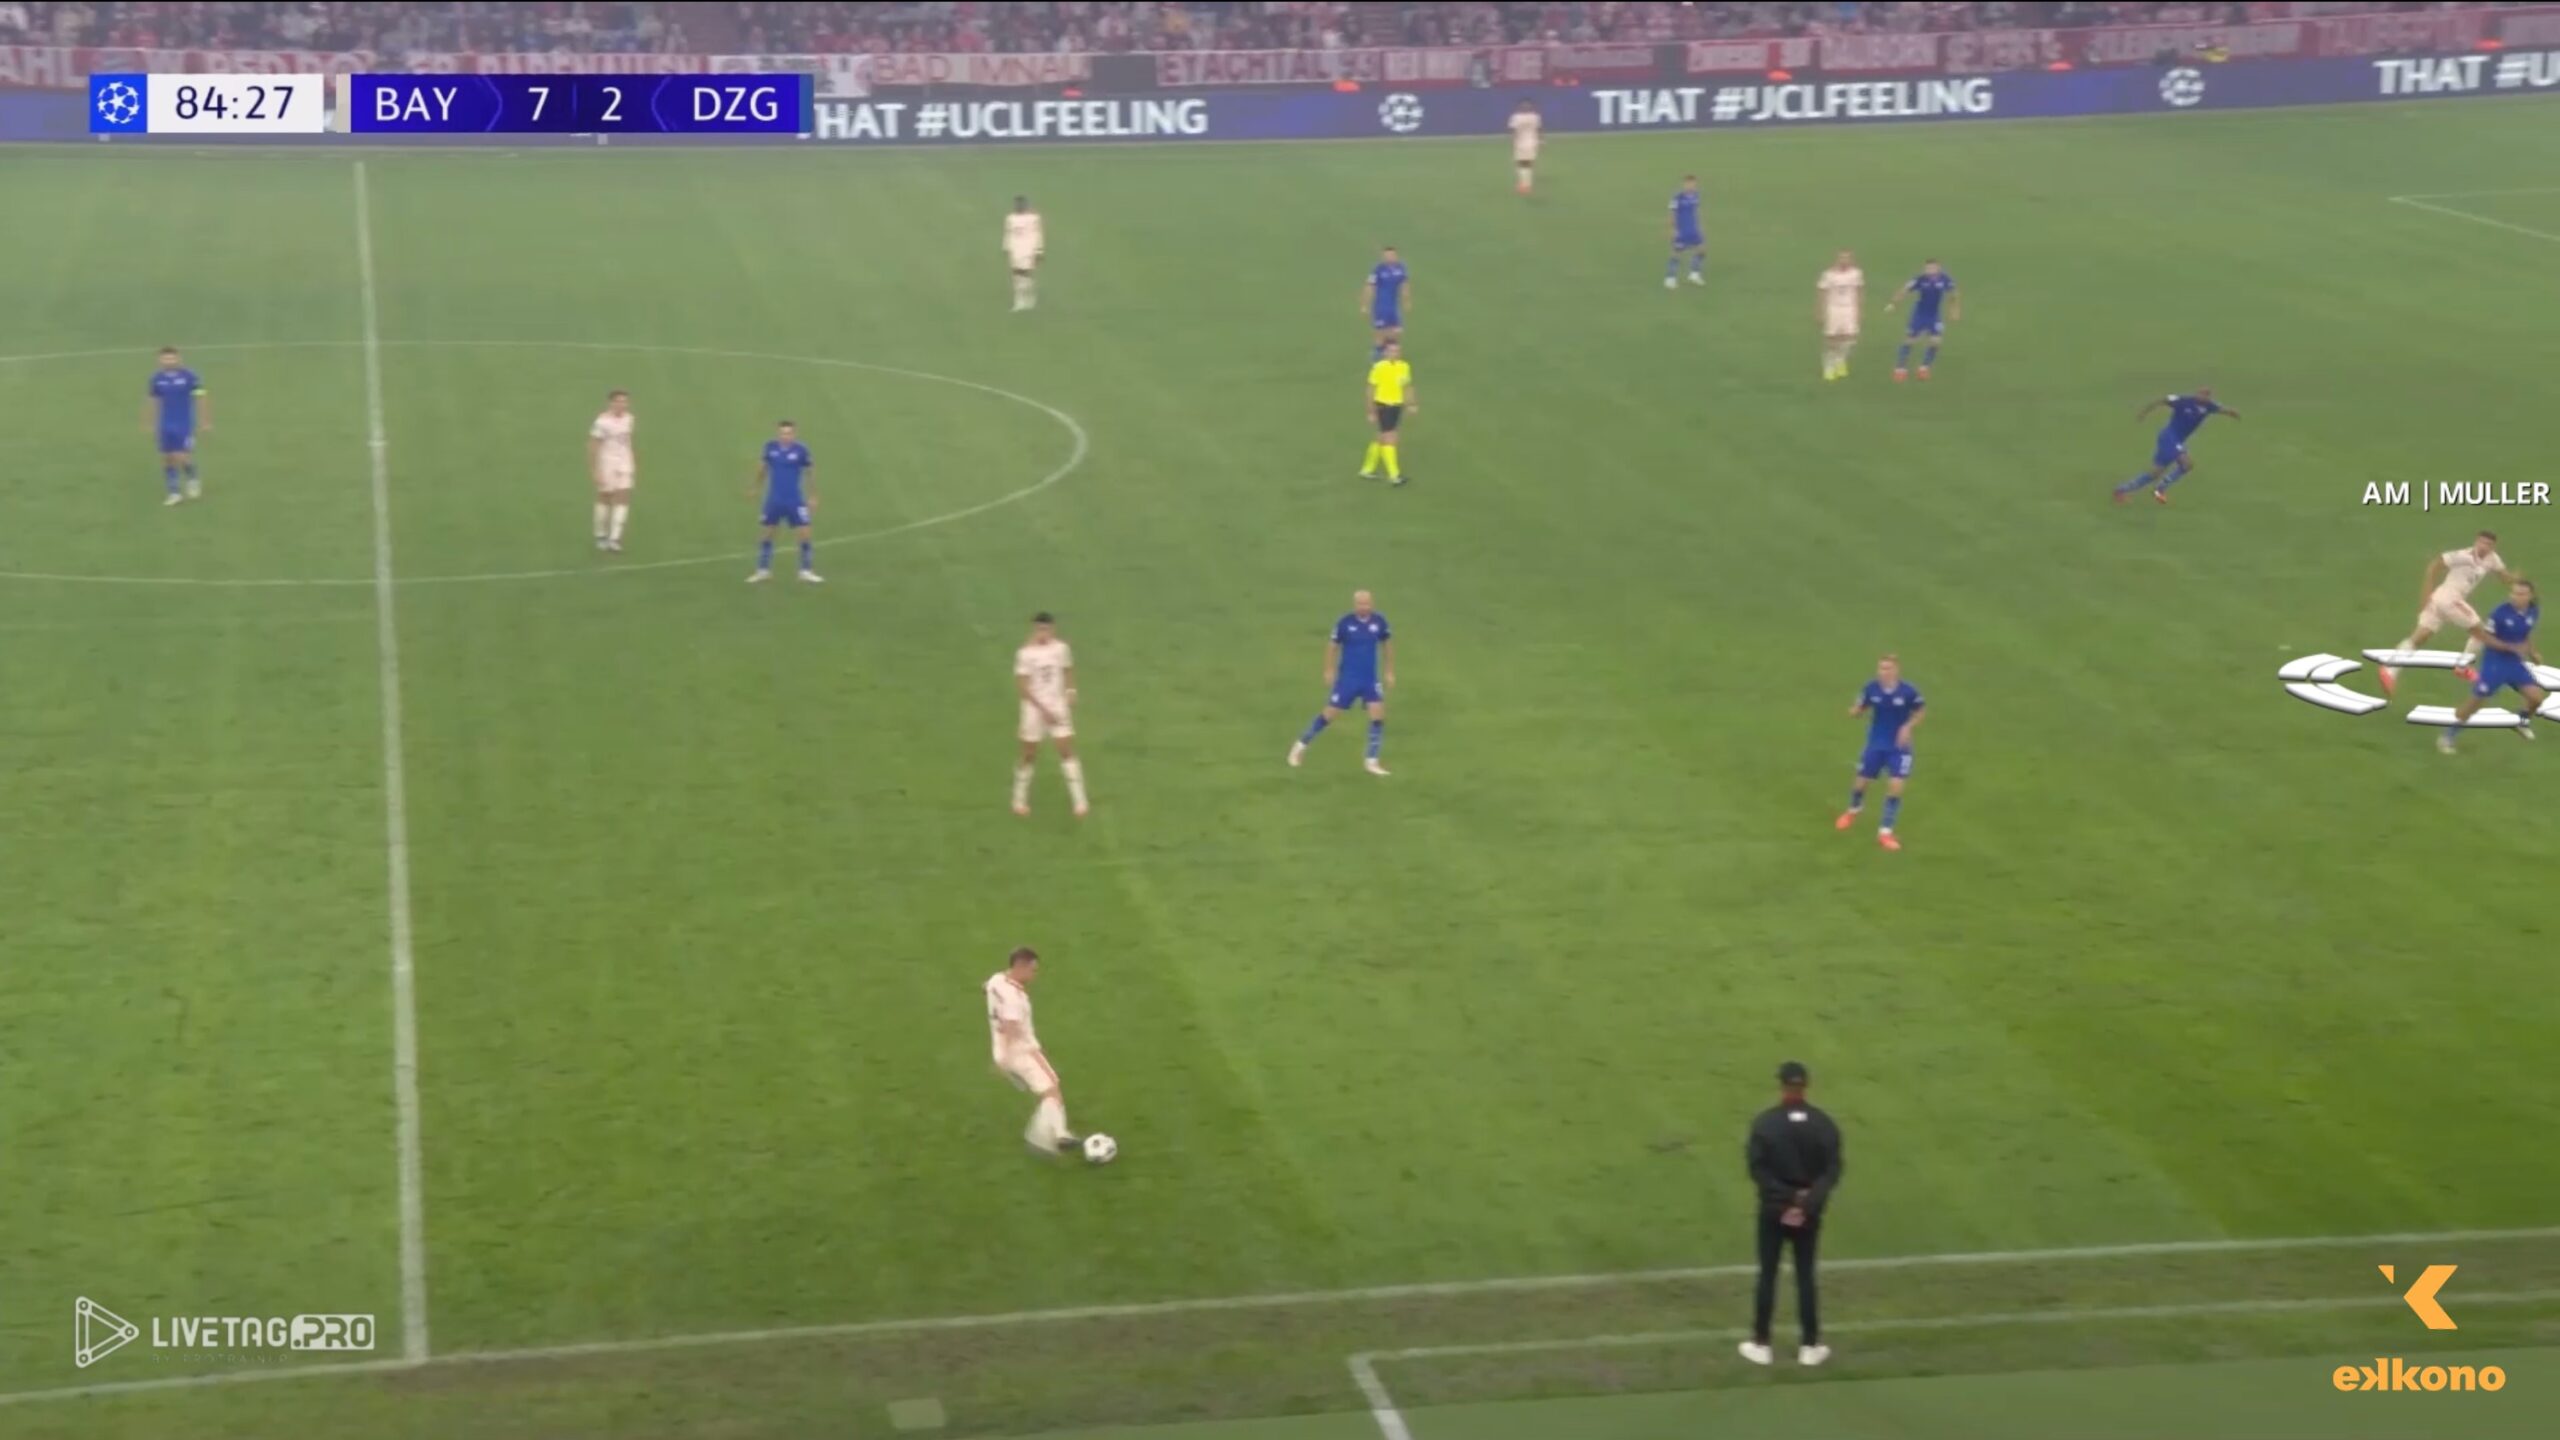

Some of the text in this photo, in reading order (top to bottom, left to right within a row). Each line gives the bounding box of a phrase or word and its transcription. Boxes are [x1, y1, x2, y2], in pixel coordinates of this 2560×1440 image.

[875, 56, 951, 82] BAD
[2373, 55, 2490, 94] THAT
[811, 99, 1208, 139] HAT #UCLFEELING
[1592, 77, 1993, 125] THAT #UCLFEELING
